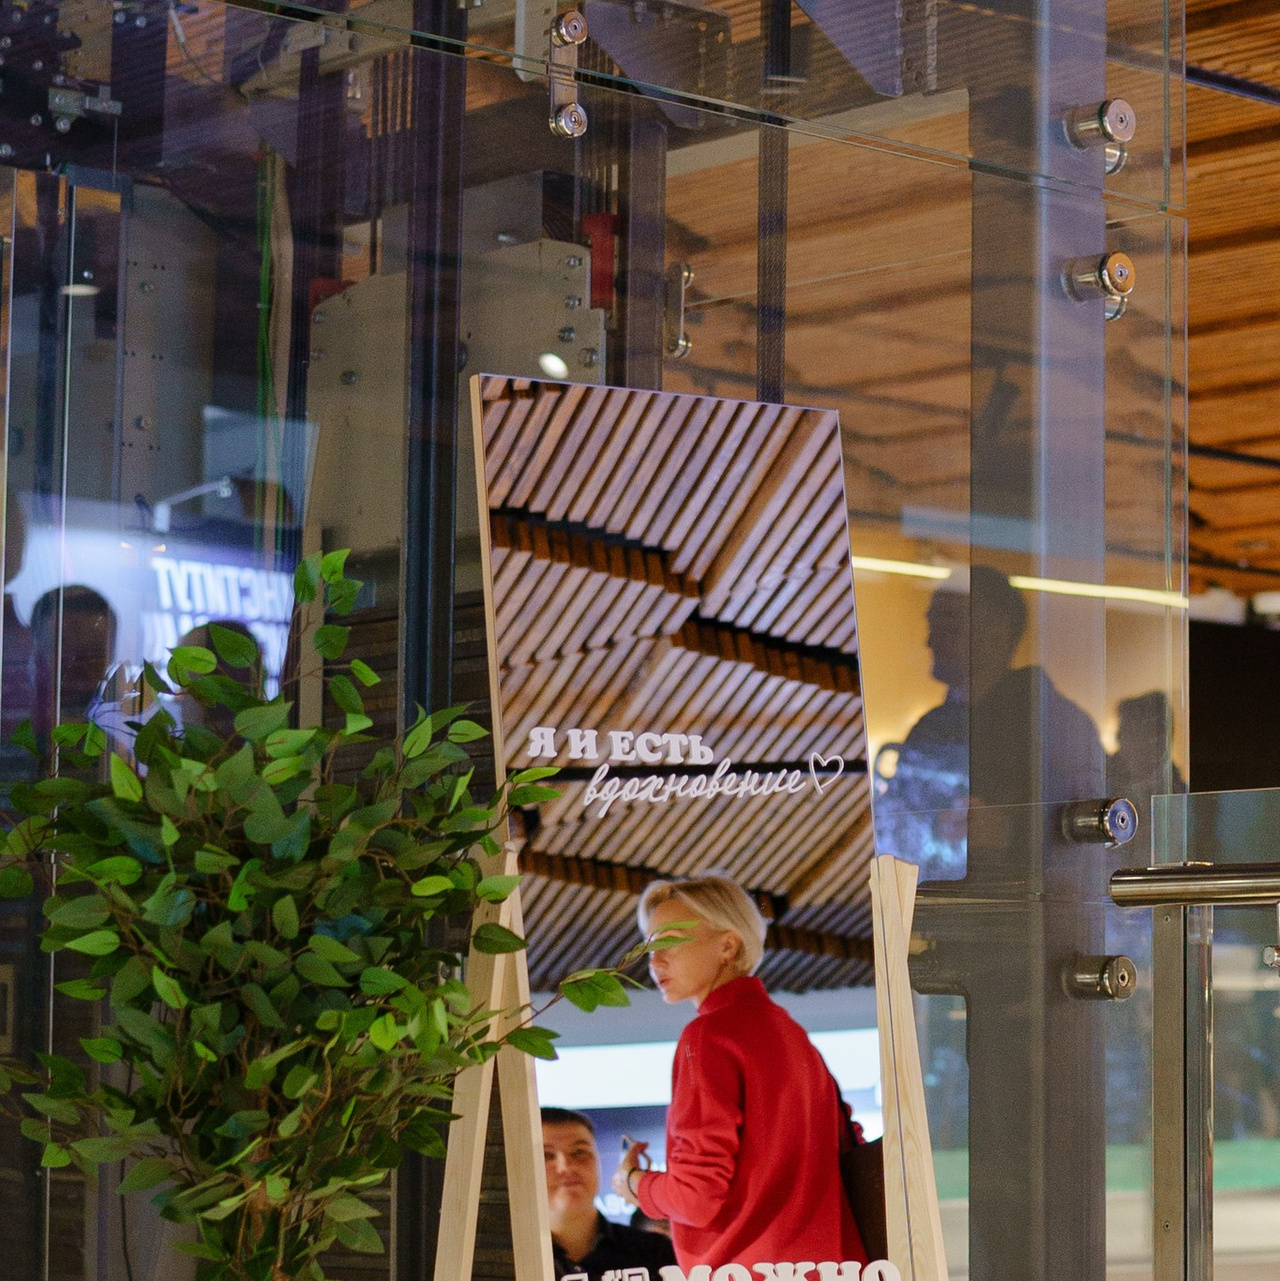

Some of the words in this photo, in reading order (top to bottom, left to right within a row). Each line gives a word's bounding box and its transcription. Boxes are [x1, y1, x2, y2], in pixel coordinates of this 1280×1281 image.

[527, 726, 558, 758] Я
[566, 728, 599, 760] И
[608, 730, 715, 766] ЕСТЬ
[583, 757, 808, 819] вдохновение
